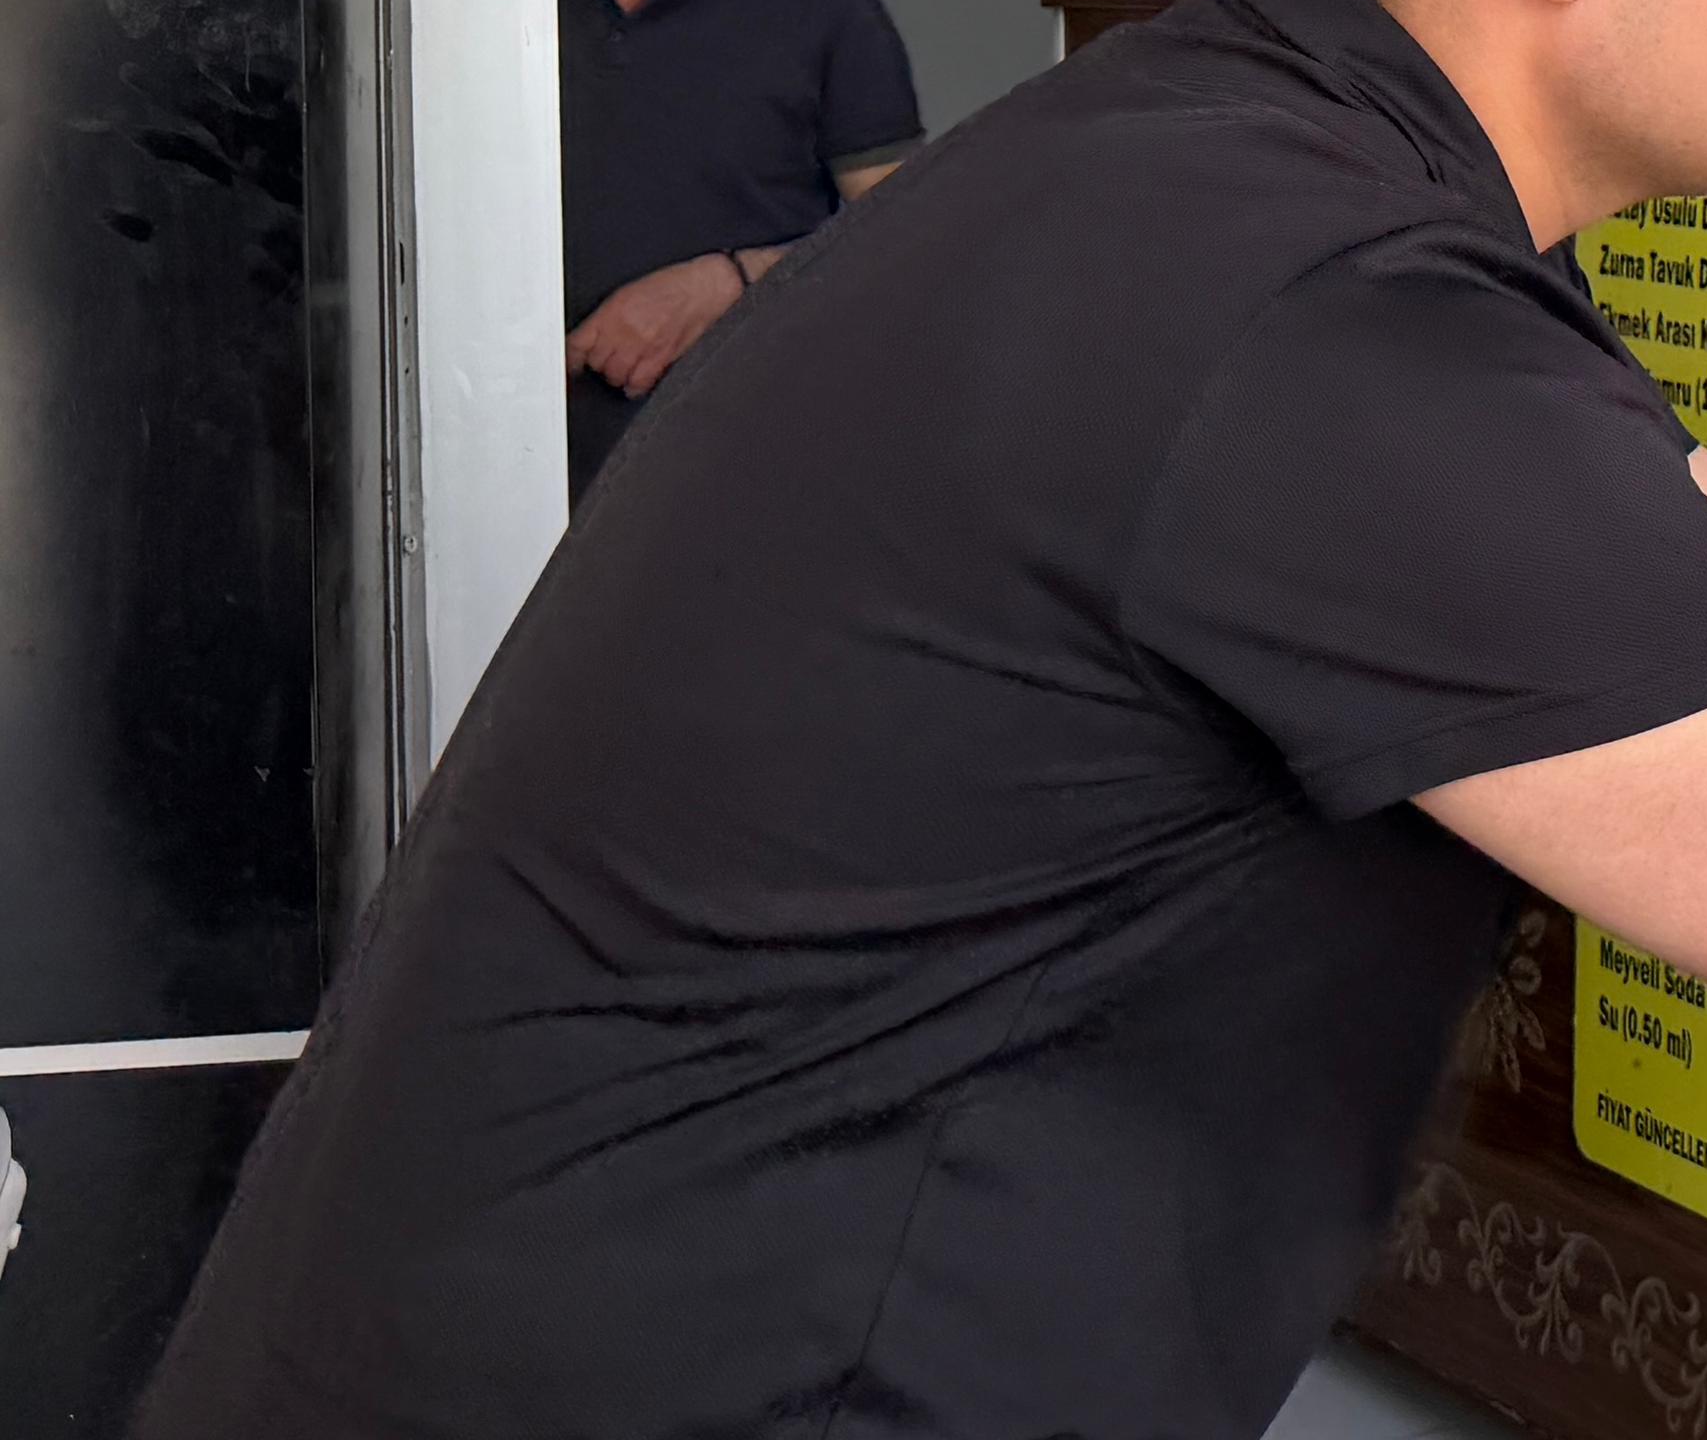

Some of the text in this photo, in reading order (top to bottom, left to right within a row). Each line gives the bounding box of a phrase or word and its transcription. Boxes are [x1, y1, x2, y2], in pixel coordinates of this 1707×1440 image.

[1599, 244, 1645, 281] Zurna
[1649, 250, 1695, 289] Tavuk
[1655, 311, 1696, 348] Arası
[1657, 378, 1692, 408] mru
[1600, 936, 1660, 990] Meyveli
[1664, 961, 1706, 1009] Soda
[1599, 995, 1692, 1069] Su (0.50 ml)
[1597, 1088, 1632, 1132] FİYAT
